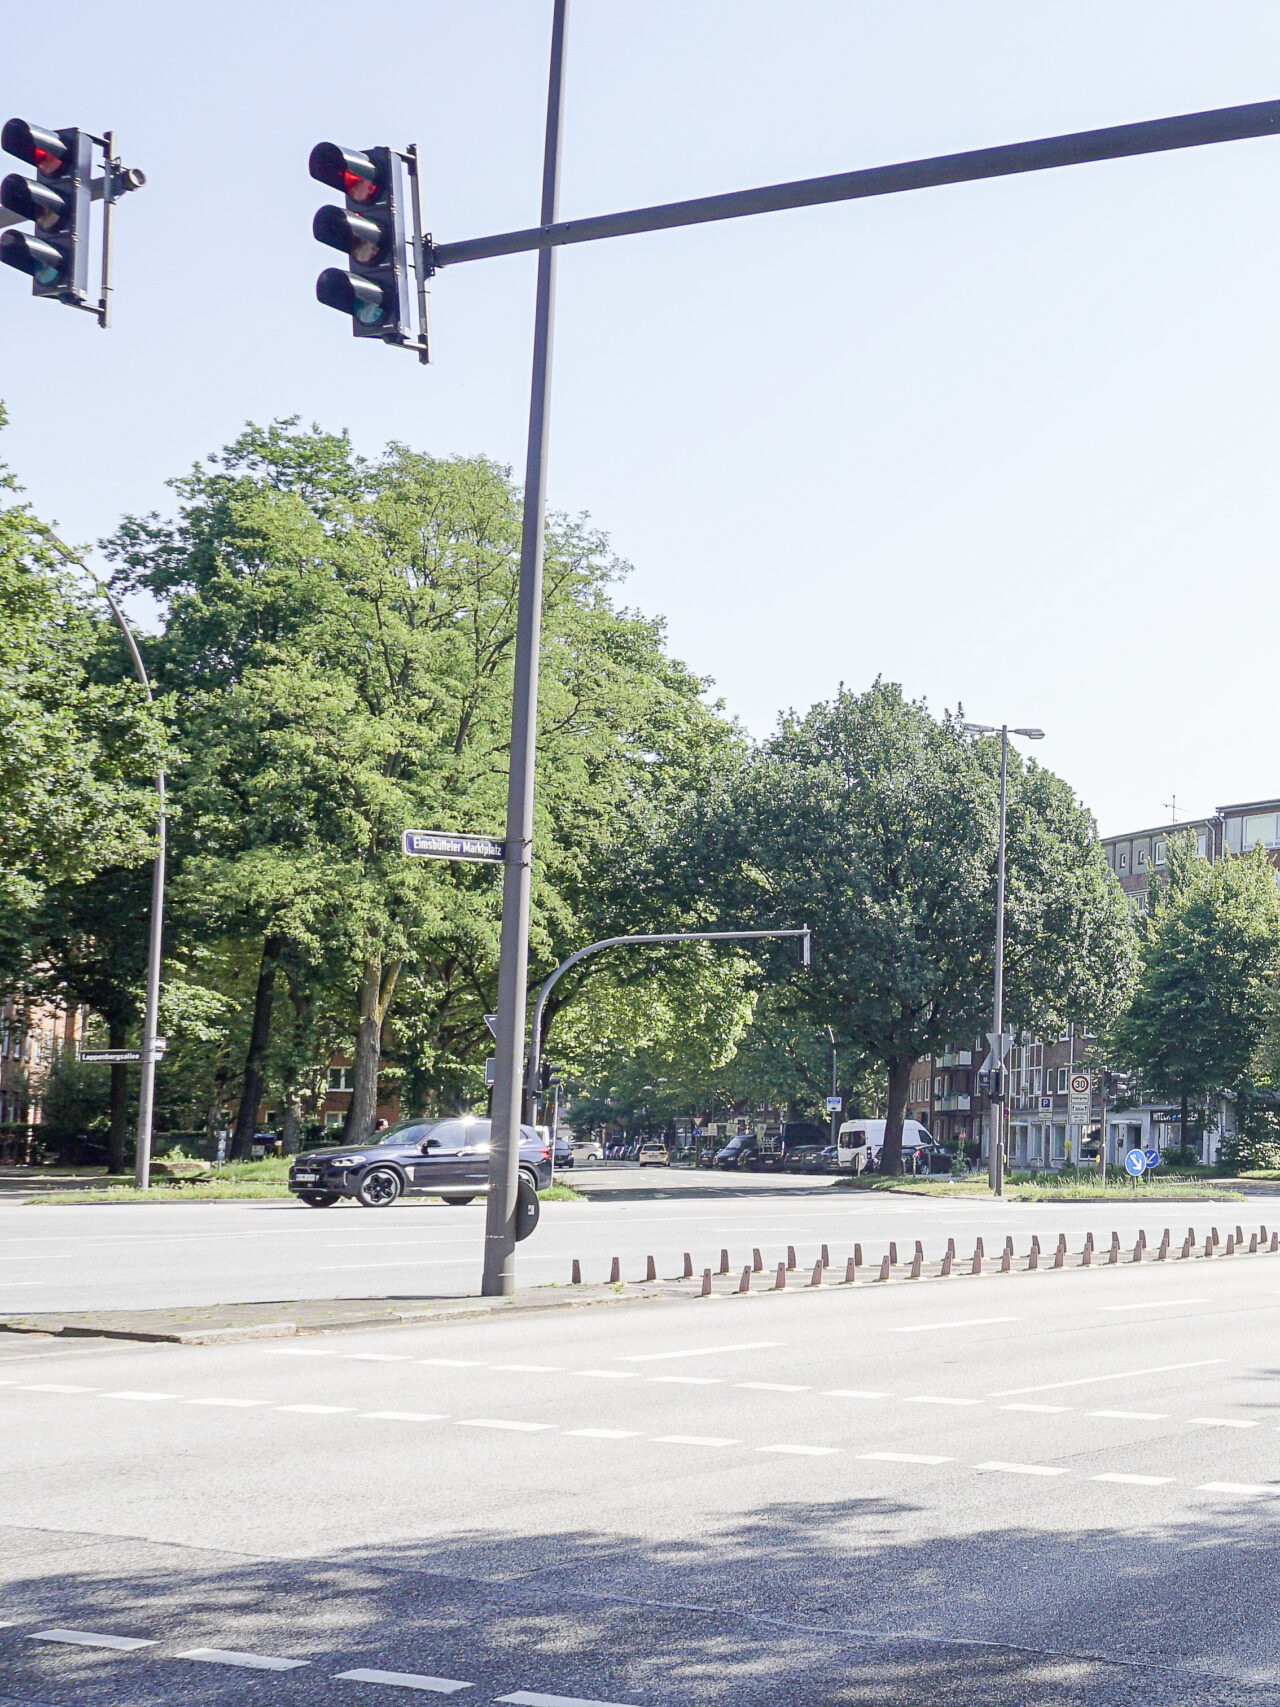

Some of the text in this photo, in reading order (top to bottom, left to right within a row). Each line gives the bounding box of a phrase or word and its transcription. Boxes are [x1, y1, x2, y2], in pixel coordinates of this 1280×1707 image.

[413, 836, 502, 857] Eimsbütteler Marktplatz
[1075, 1080, 1086, 1089] 30
